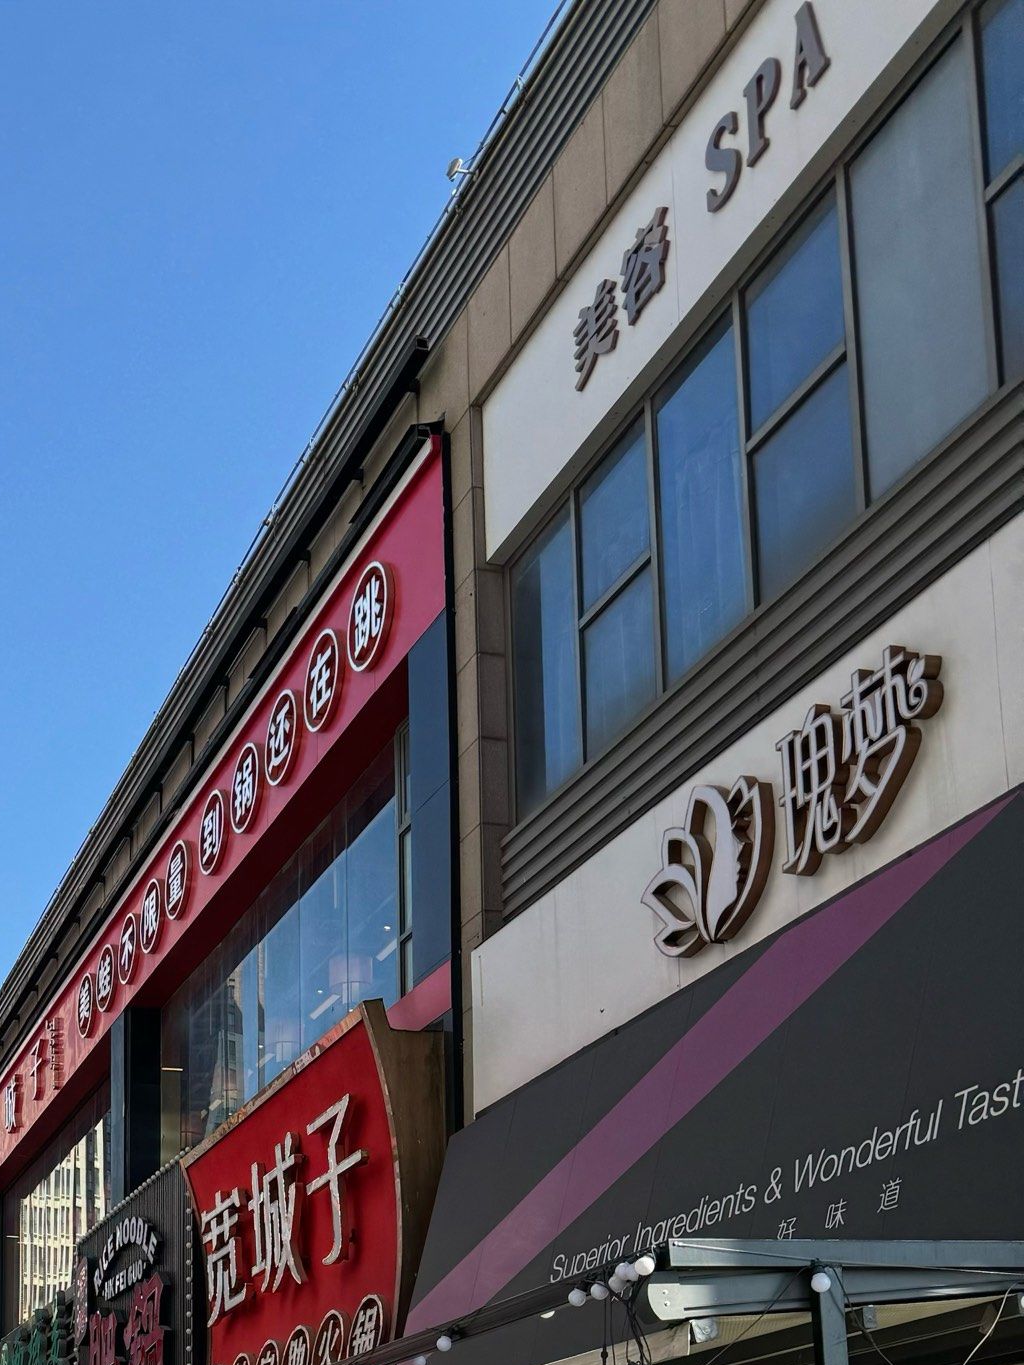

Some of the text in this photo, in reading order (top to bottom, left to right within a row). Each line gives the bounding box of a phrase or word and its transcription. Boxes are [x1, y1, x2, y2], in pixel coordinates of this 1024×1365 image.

[573, 1, 831, 391] 美容 SPA
[77, 572, 386, 1024] 美蛙不限量到锅还在跳
[93, 1216, 158, 1297] RICE NOODLE
[115, 1269, 128, 1294] FEI
[127, 1260, 144, 1286] GUO
[201, 1093, 368, 1329] 宽城子
[550, 1234, 629, 1284] Superior
[635, 1184, 756, 1249] Ingredients
[765, 1167, 783, 1204] &
[794, 1099, 943, 1194] Wonderful
